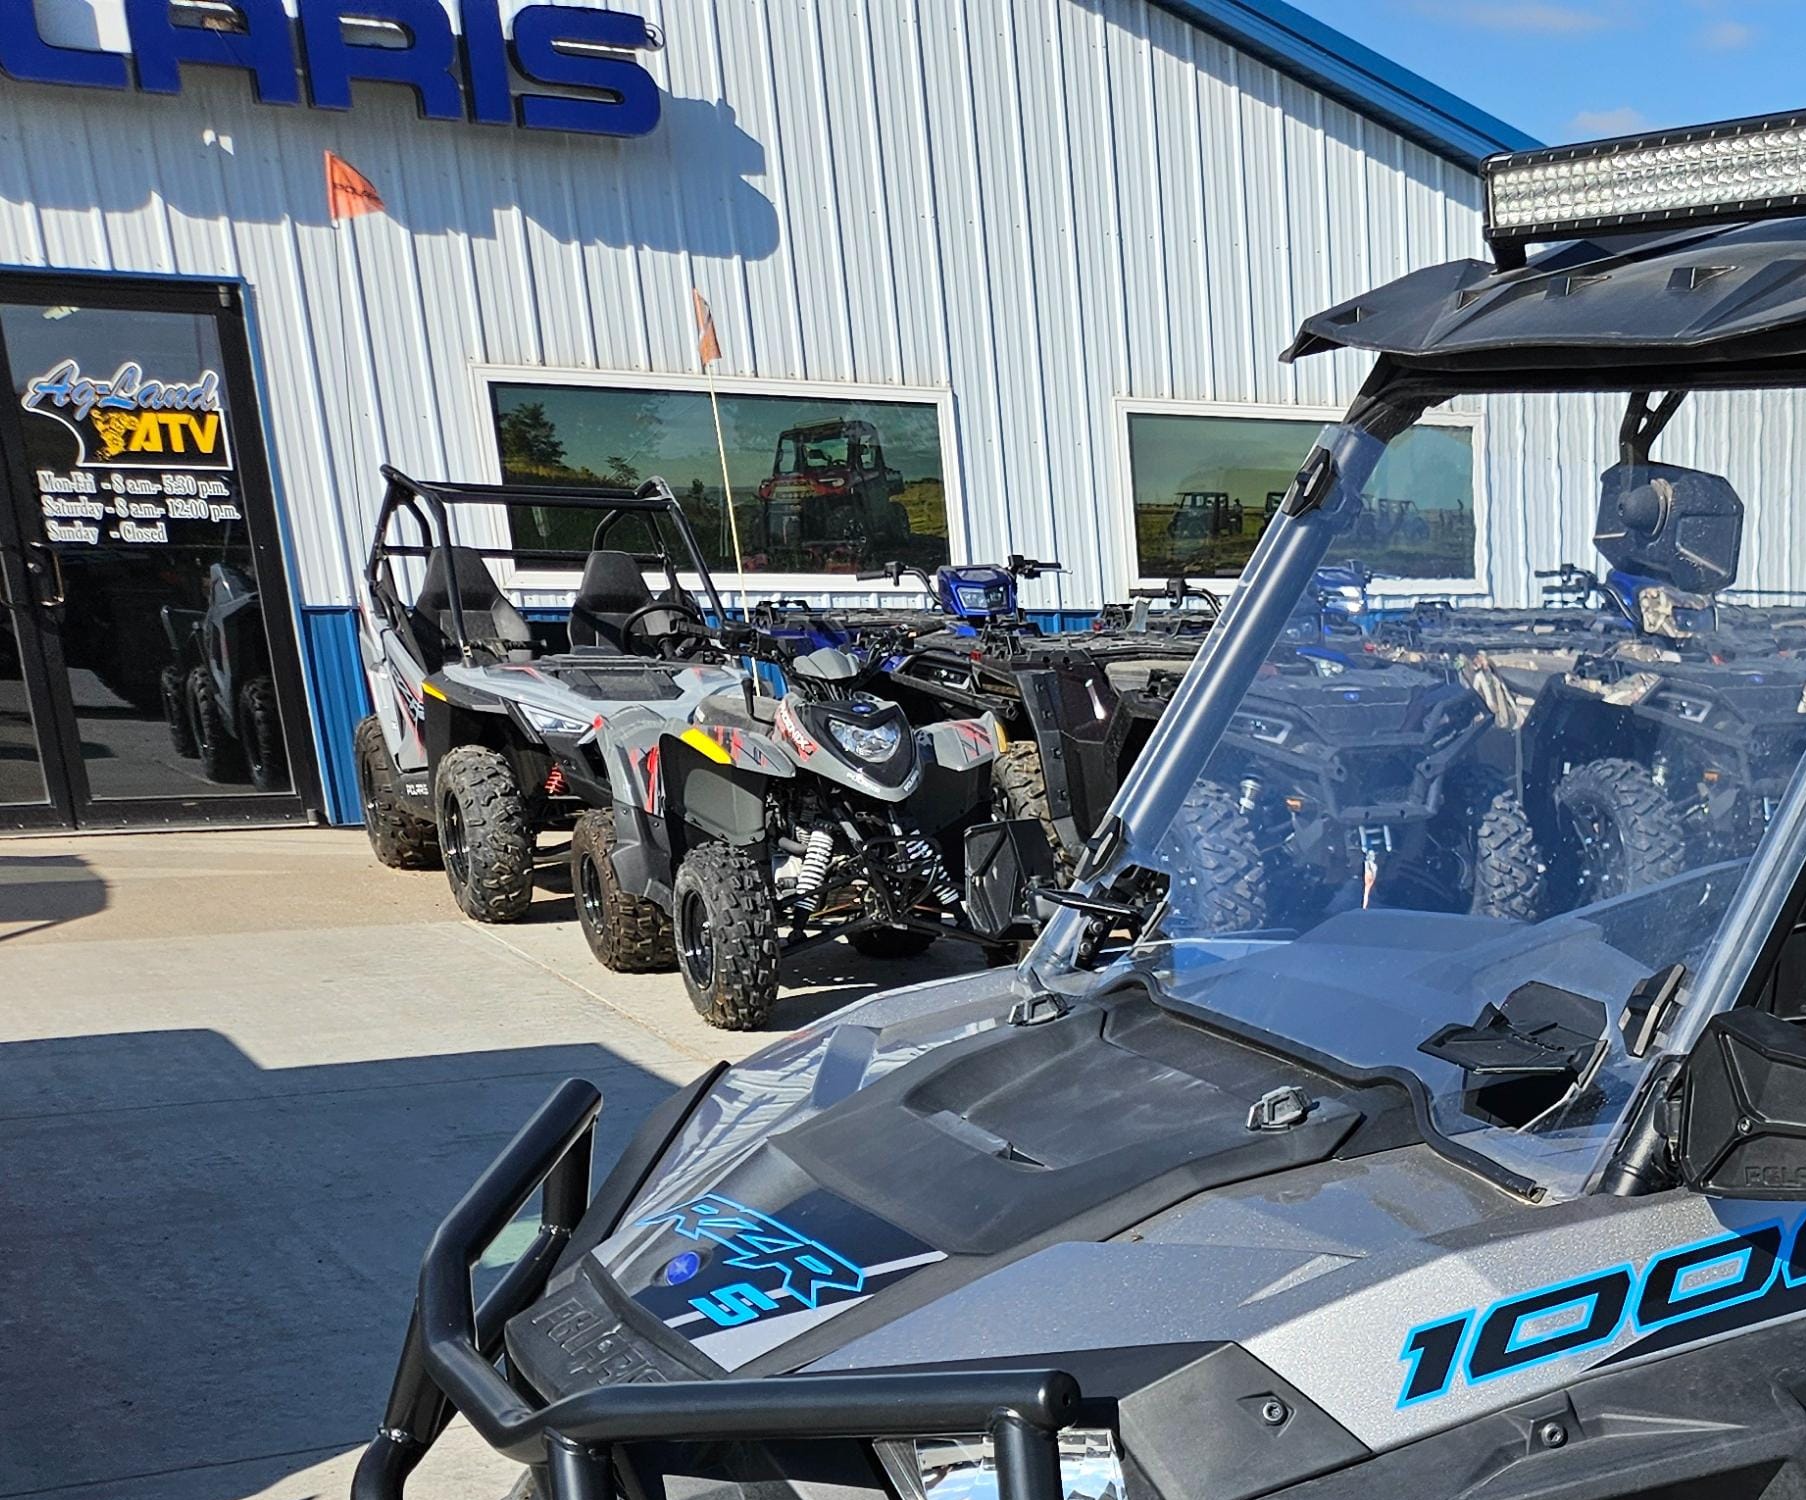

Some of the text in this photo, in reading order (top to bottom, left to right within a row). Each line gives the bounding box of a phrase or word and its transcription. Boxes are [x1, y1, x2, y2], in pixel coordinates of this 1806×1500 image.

[25, 361, 219, 421] Ag-Land
[127, 411, 219, 453] ATV
[110, 474, 125, 495] 8
[161, 474, 197, 496] 5:30
[199, 480, 230, 498] p.m.
[41, 496, 104, 521] Saturday
[115, 497, 129, 519] 8
[168, 498, 209, 520] 12:00
[210, 503, 242, 522] p.m.
[45, 519, 99, 545] Sunday
[119, 521, 169, 544] Closed
[635, 1193, 865, 1310] RZR
